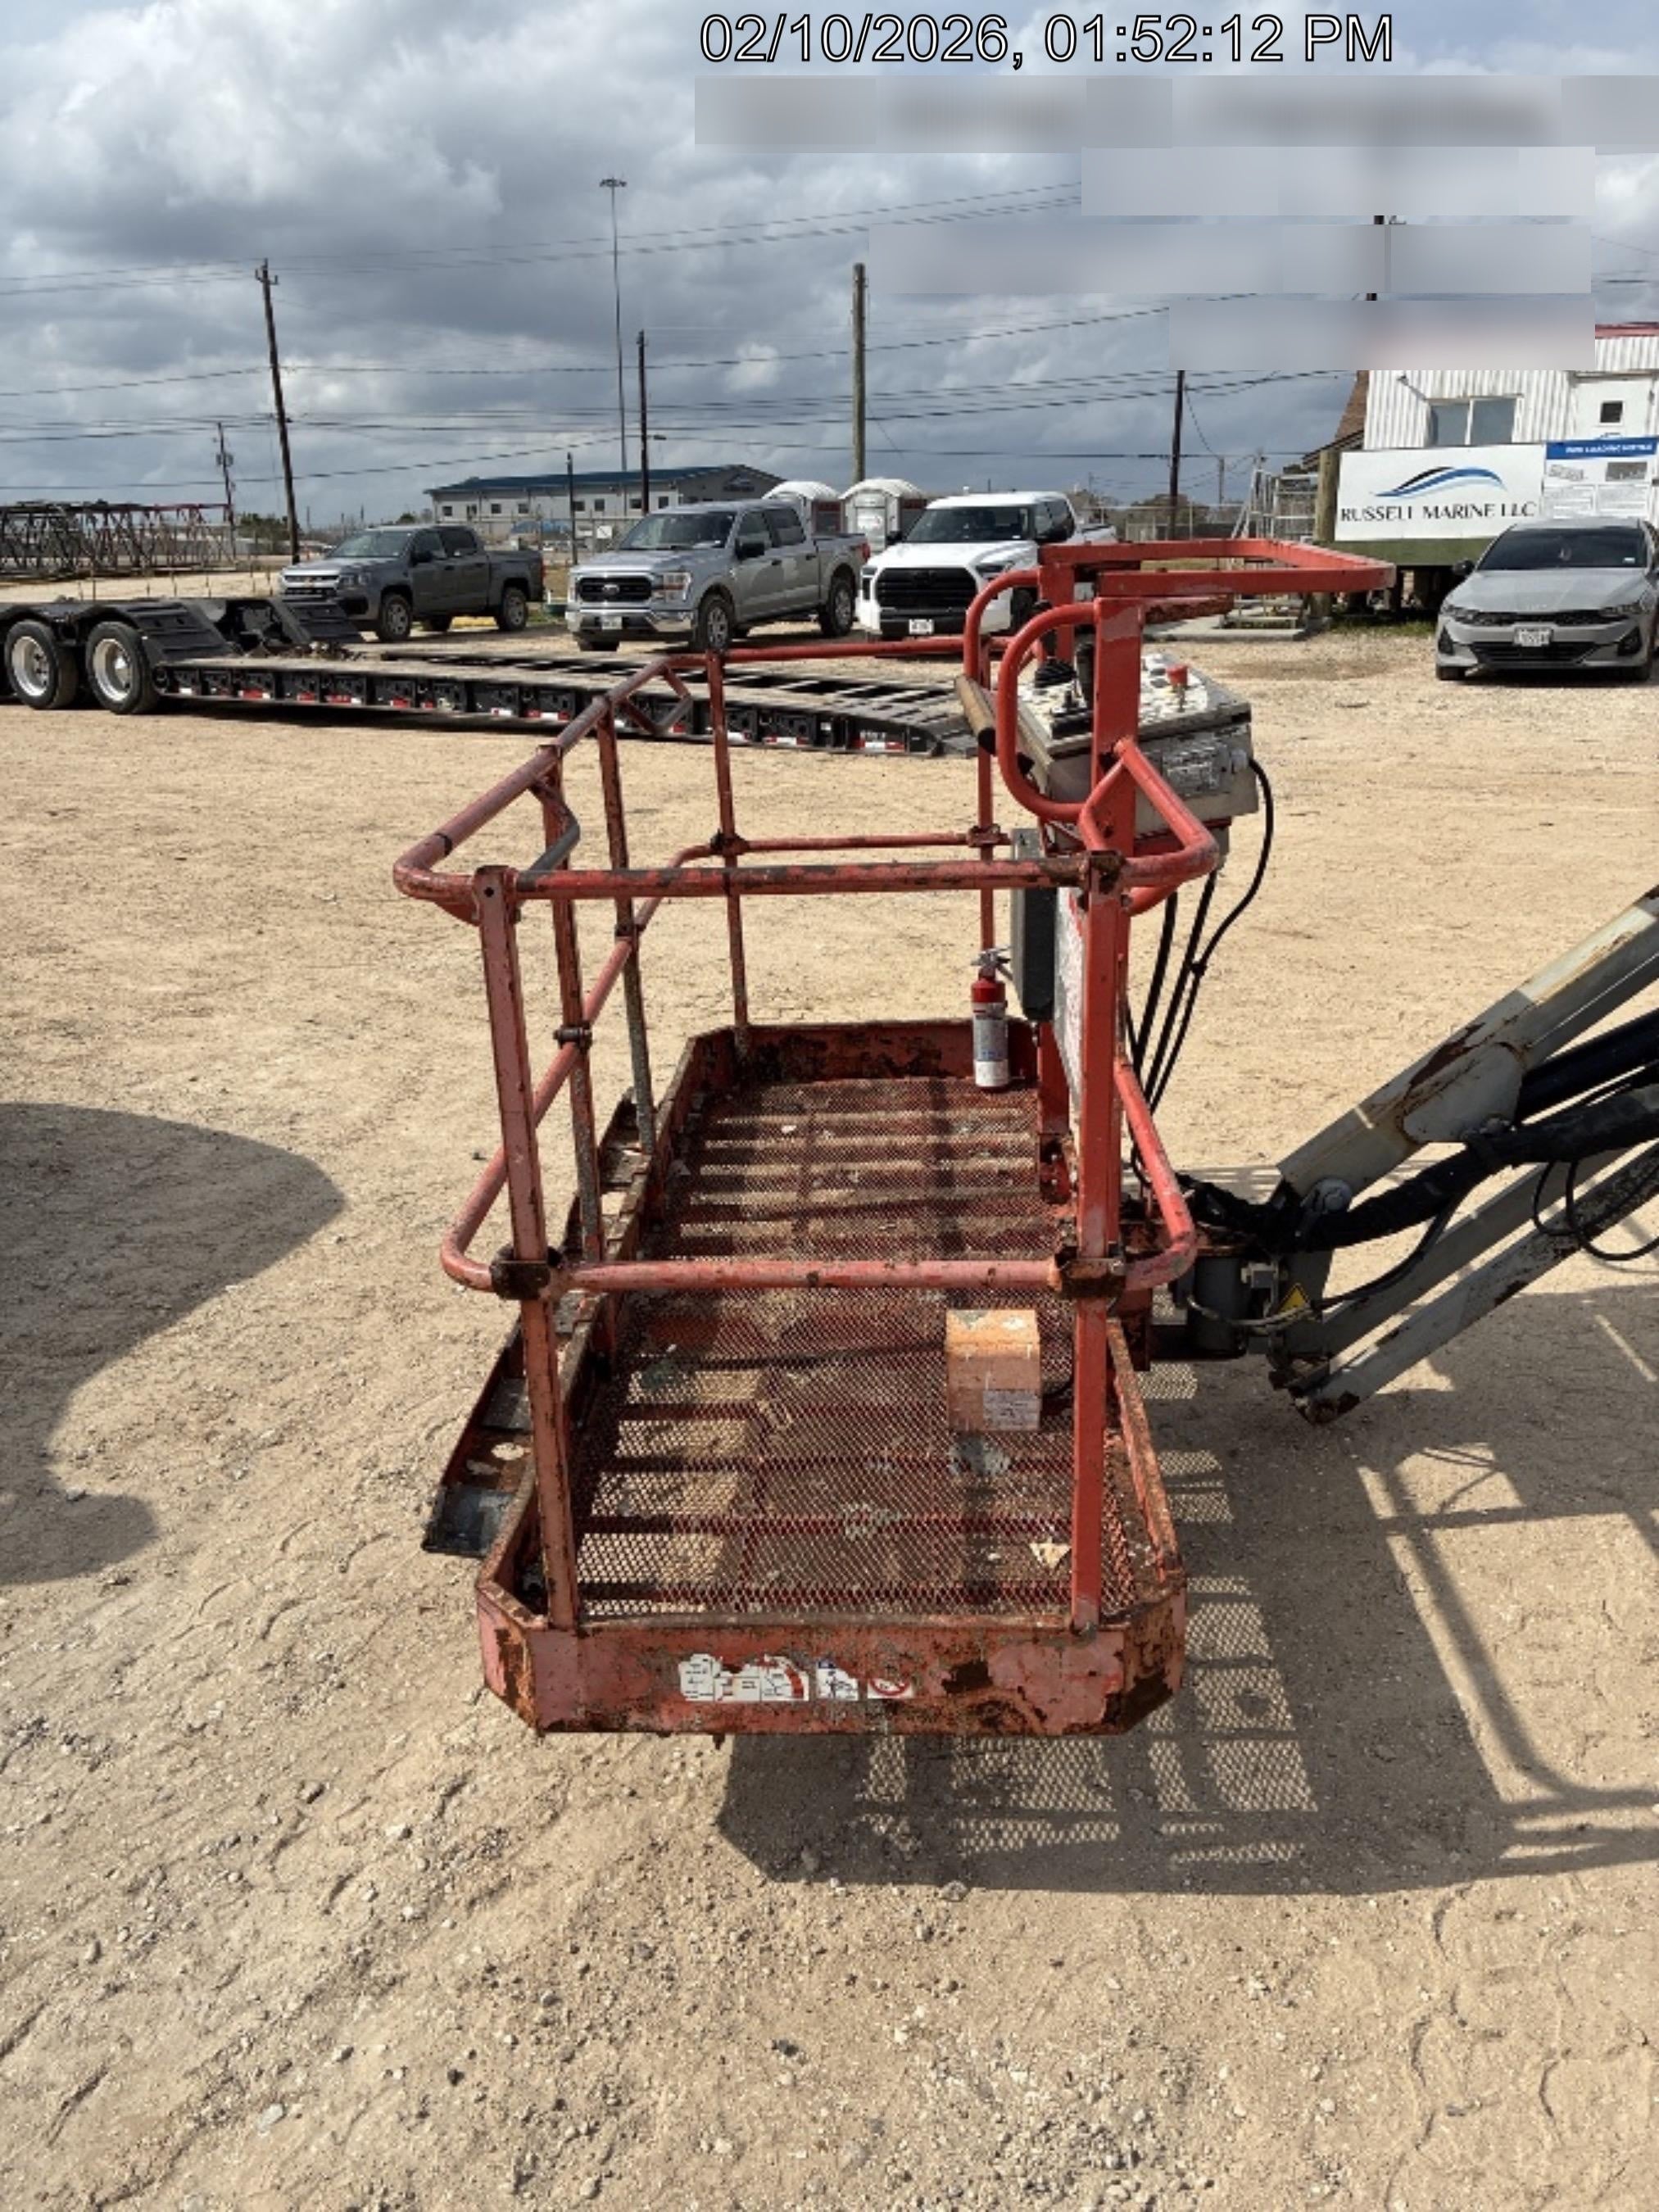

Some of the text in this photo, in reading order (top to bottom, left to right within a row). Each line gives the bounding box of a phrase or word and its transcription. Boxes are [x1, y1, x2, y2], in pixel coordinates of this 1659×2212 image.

[1341, 501, 1538, 522] RUSSELL MARINE LLC
